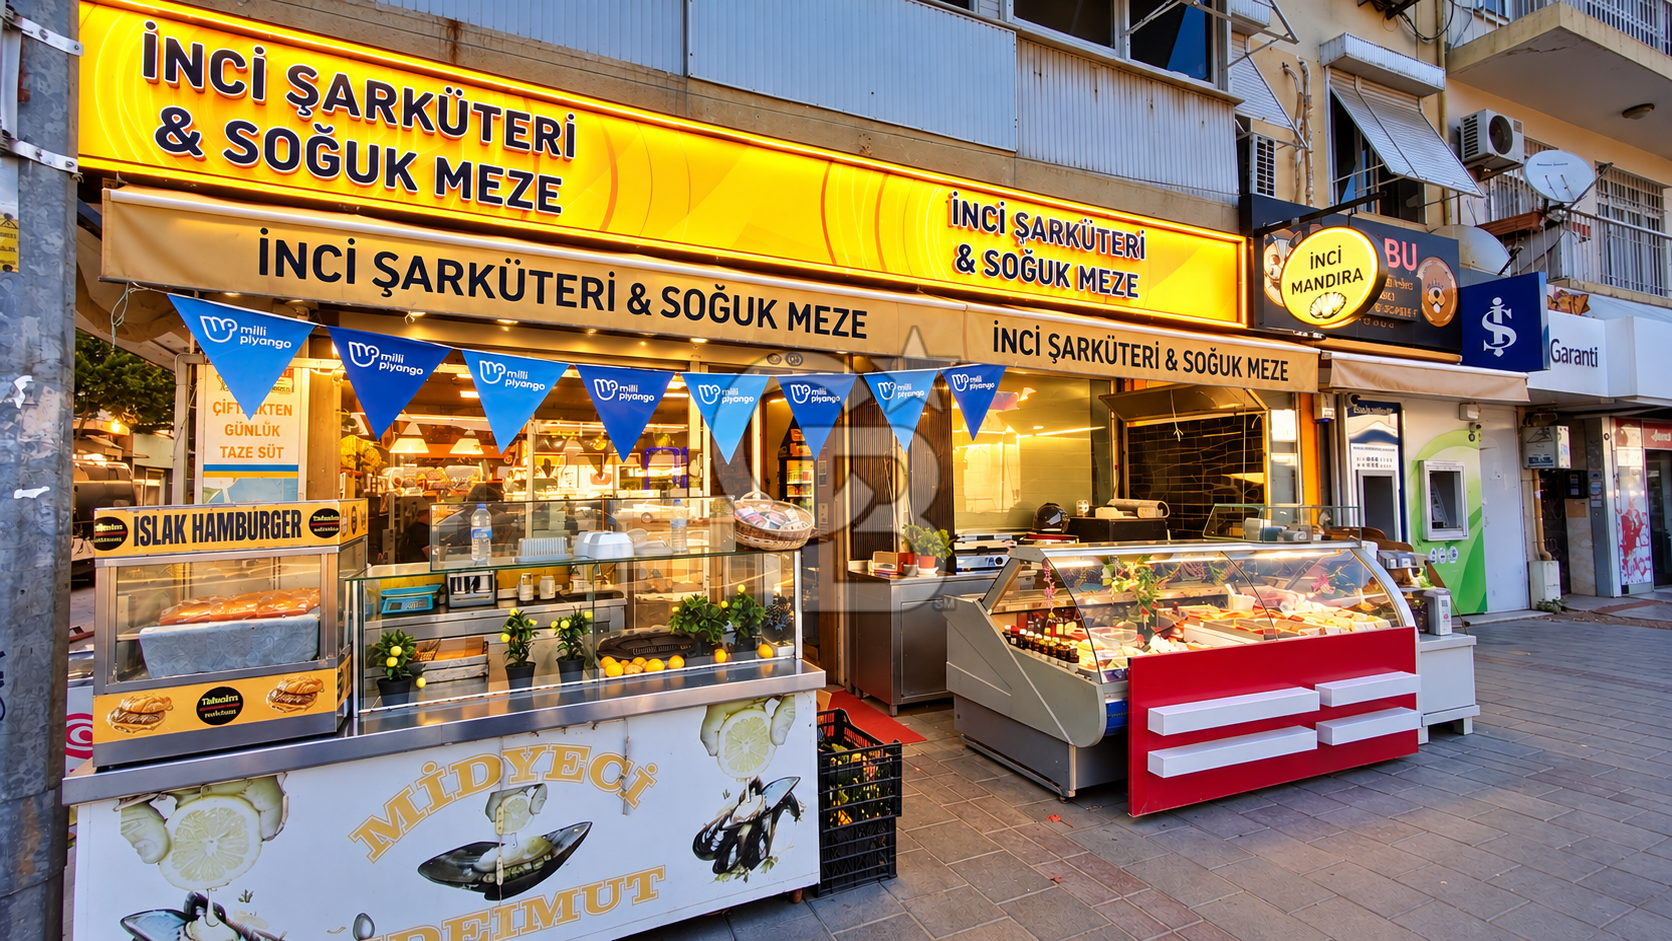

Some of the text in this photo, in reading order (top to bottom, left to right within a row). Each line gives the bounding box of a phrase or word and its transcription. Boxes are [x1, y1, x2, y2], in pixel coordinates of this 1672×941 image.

[143, 20, 576, 159] İNCİ ŞARKÜTERİ
[154, 106, 563, 215] & SOĞUK MEZE
[951, 190, 1147, 261] İNCİ ŞARKÜTERİ
[1310, 245, 1342, 270] İNCİ
[258, 227, 868, 340] İNCİ ŞARKÜTERİ & SOĞUK MEZE
[955, 243, 1140, 299] & SOĞUK MEZE
[1291, 267, 1364, 296] MANDIRA
[239, 334, 292, 350] piyango
[240, 325, 267, 338] milli
[379, 352, 405, 364] milli
[993, 320, 1289, 382] İNCİ ŞARKÜTERİ & SOĞUK MEZE
[1550, 338, 1598, 368] Garanti
[378, 361, 424, 376] piyango
[506, 370, 529, 380] milli
[504, 378, 546, 392] piyango
[618, 391, 655, 403] piyango
[619, 384, 639, 393] milli
[212, 398, 293, 416] ÇİFTKTEN
[219, 443, 284, 459] TAZE SÜT
[133, 509, 302, 547] ISLAK HAMBURGER
[348, 743, 658, 864] MİDYECİ
